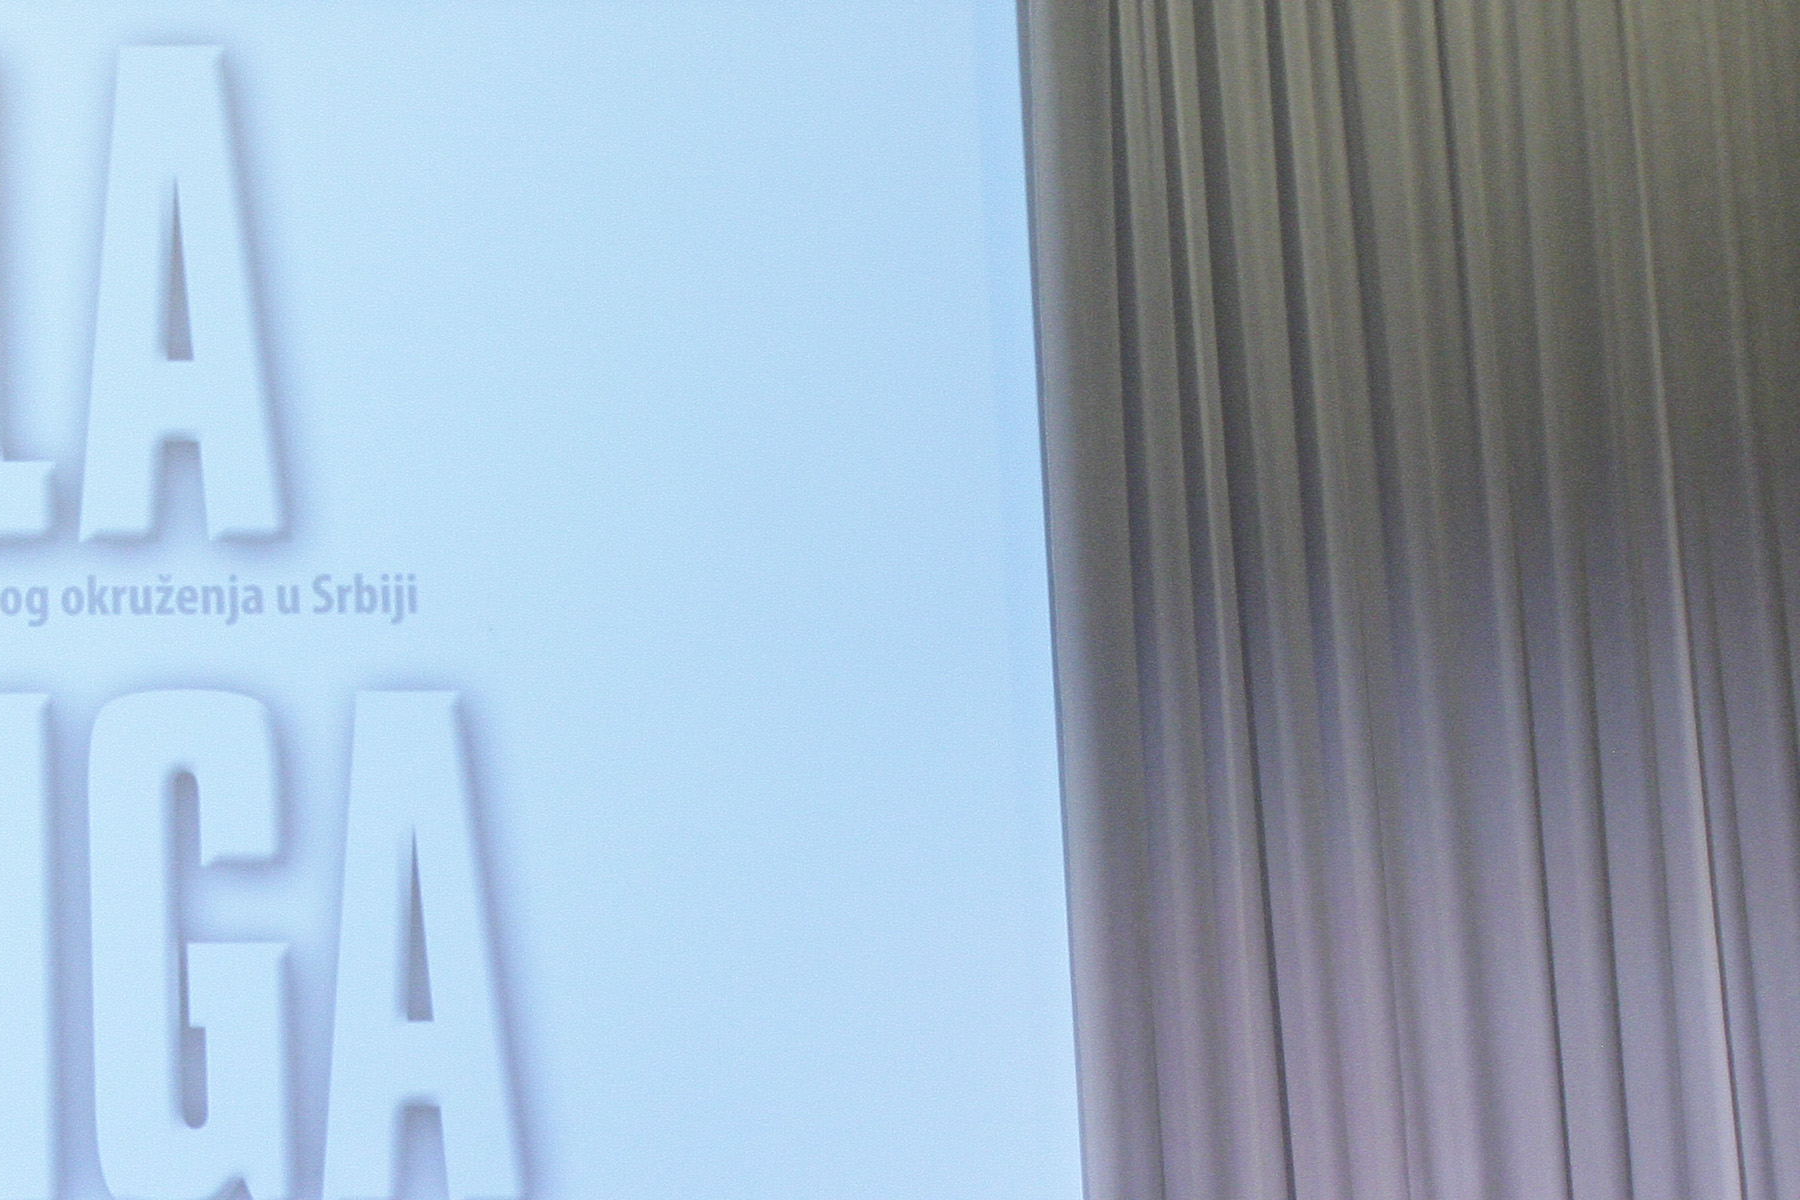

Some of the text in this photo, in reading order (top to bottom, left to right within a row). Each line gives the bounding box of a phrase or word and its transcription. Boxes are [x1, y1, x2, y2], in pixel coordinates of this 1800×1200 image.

[61, 574, 264, 626] okruženja
[276, 583, 300, 615] u
[312, 572, 418, 625] Srbiji
